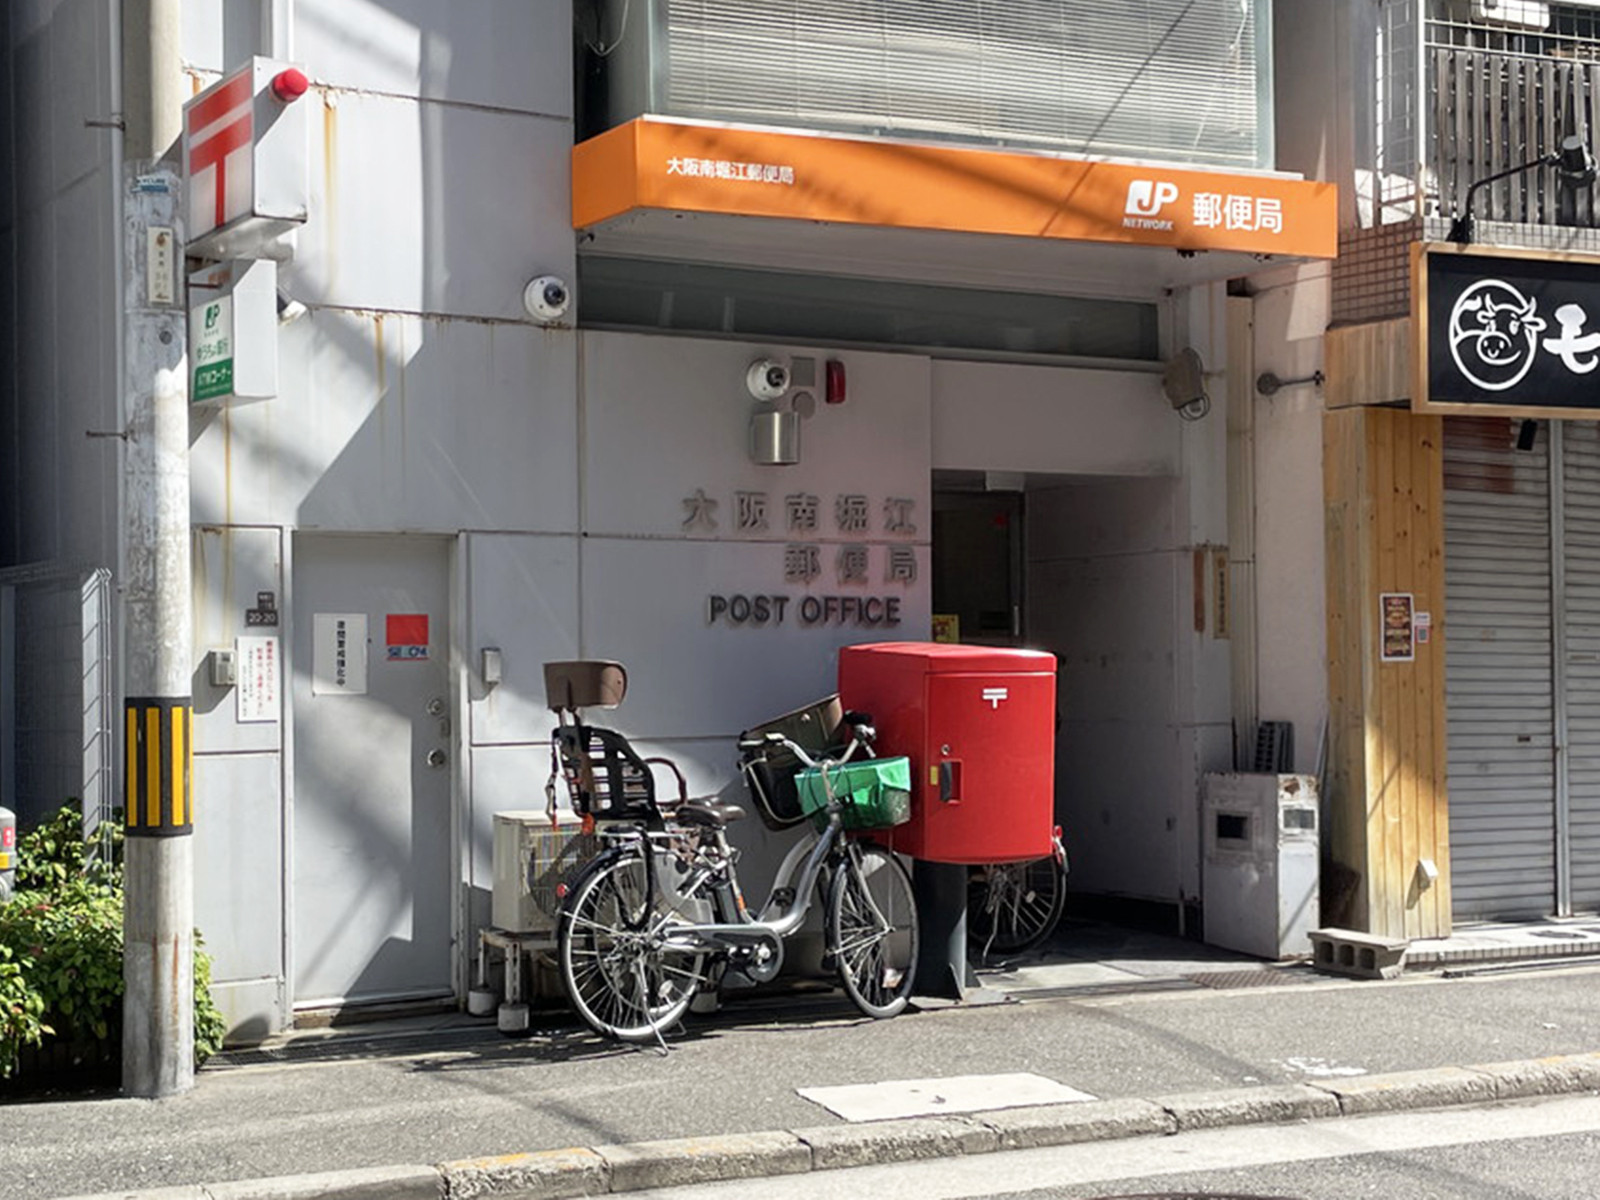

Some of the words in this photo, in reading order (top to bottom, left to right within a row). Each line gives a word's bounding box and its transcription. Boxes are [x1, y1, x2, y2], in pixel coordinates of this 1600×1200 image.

[666, 156, 795, 185] 大阪南堀江郵便局
[1122, 216, 1174, 232] NETWORK
[1193, 192, 1283, 234] 郵便局
[682, 488, 918, 533] 大阪南堀江
[784, 543, 918, 585] 郵便局
[707, 594, 790, 625] POST
[800, 595, 902, 626] OFFICE
